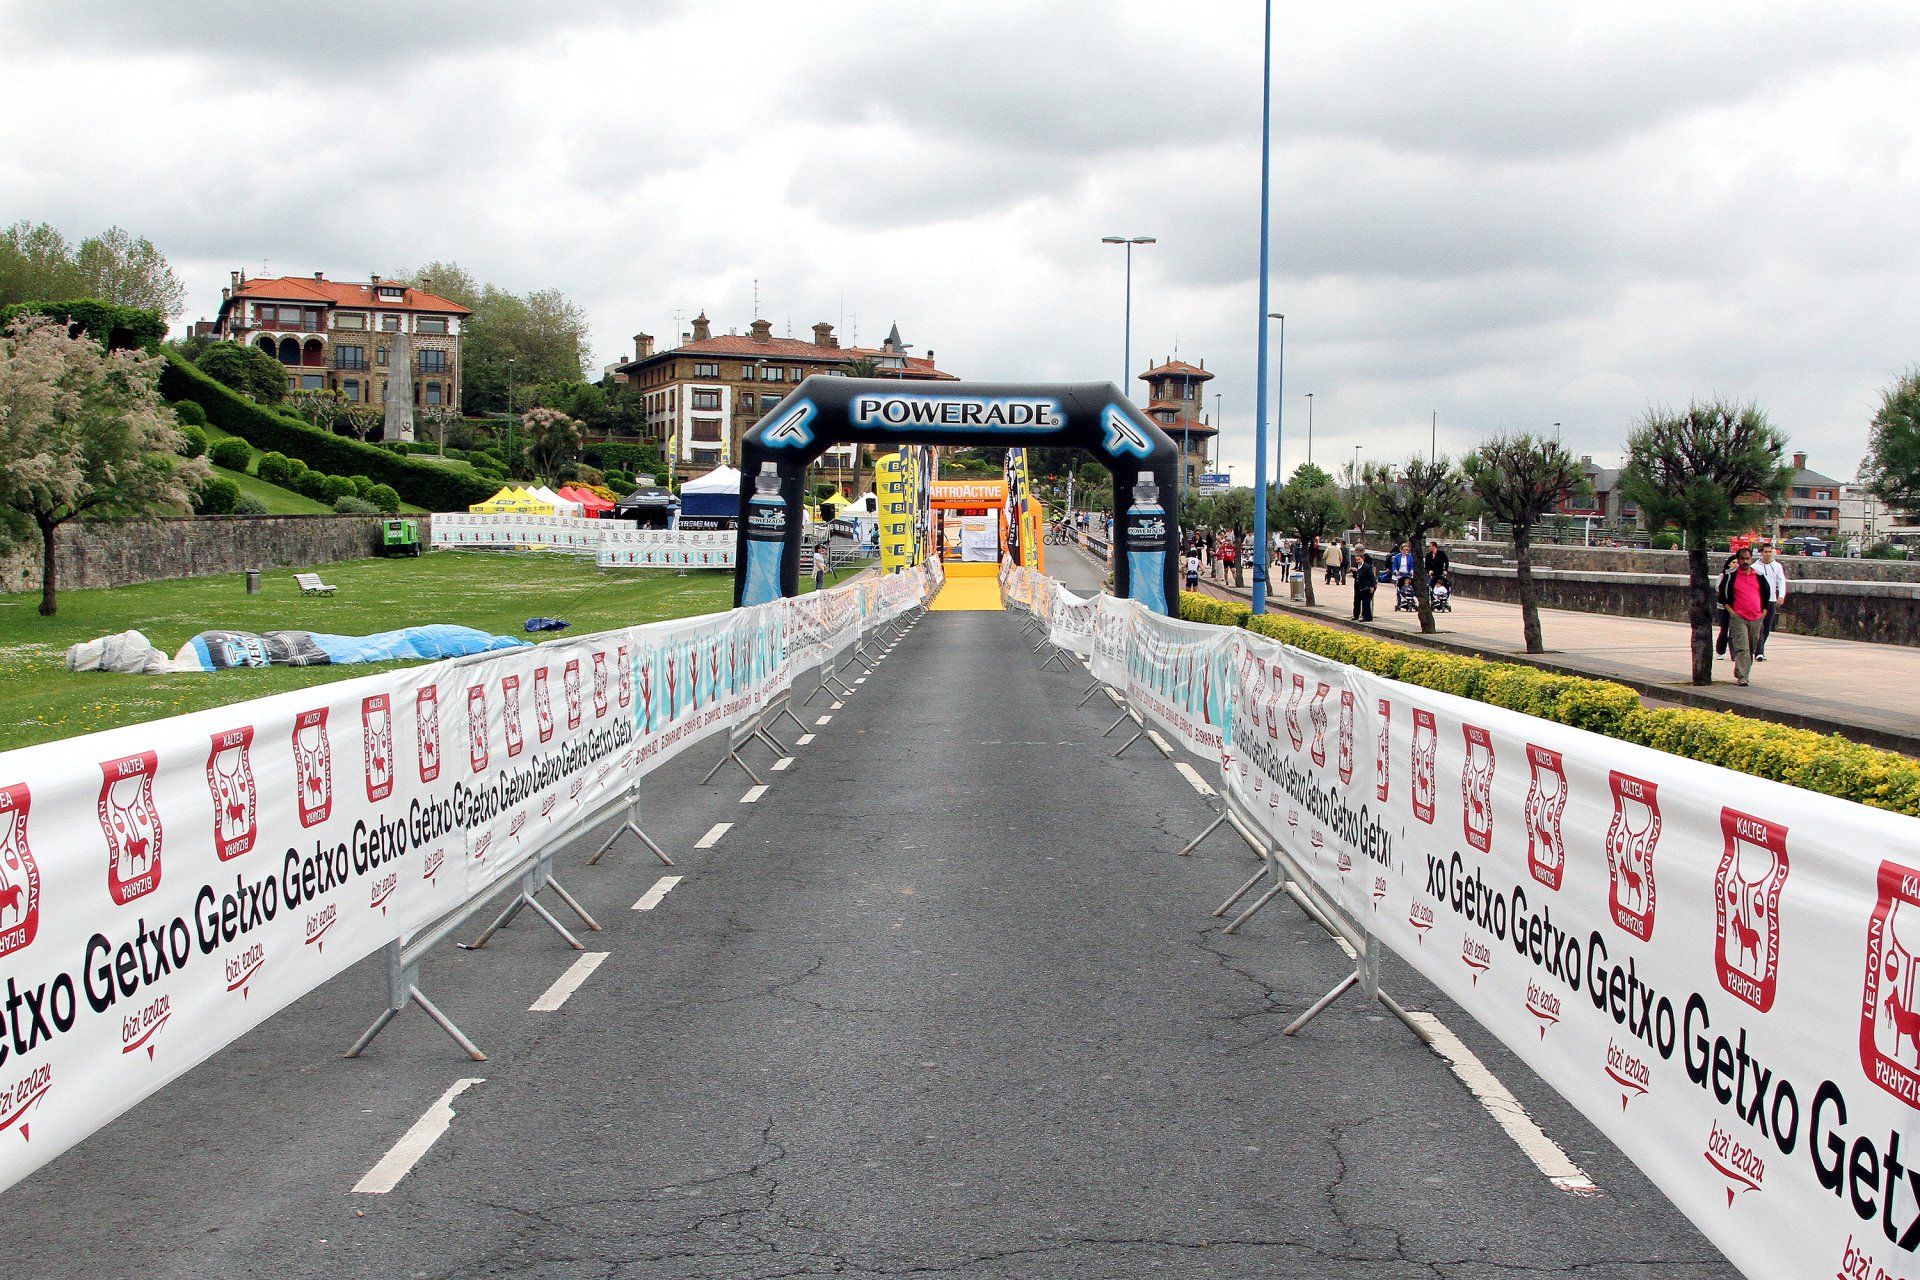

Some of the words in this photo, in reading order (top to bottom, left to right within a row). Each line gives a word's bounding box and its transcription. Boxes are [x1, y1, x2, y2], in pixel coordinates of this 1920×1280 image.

[117, 758, 145, 776] KALTEA
[223, 732, 244, 748] KALTEA
[208, 768, 222, 829] LEPOAN
[242, 750, 256, 827] DAGIANAK
[500, 769, 532, 811] Getxo
[532, 754, 562, 790] Getxo
[1306, 768, 1329, 826] Getxo
[1620, 778, 1644, 800] KALTEA
[99, 800, 118, 868] LEPOAN
[144, 778, 162, 862] DAGIANAK
[410, 794, 450, 849] Getxo
[463, 782, 498, 830] Getxo
[1330, 786, 1358, 848] Getxo
[1554, 780, 1566, 866] DAGIANAK
[1736, 816, 1768, 844] KALTEA
[18, 815, 37, 912] DAGIANAK
[352, 810, 406, 875] Getxo
[1606, 812, 1620, 882] LEPOAN
[1644, 815, 1660, 914] DAGIANAK
[121, 876, 152, 900] BIZARRA
[282, 840, 348, 909] Getxo
[1449, 850, 1506, 942] Getxo
[1716, 854, 1732, 939] LEPOAN
[194, 874, 277, 955] Getxo
[306, 915, 320, 936] bizi
[320, 902, 338, 928] ezazu
[1512, 885, 1581, 992] Getxo
[1617, 908, 1644, 936] BIZARRA
[1766, 864, 1788, 981] DAGIANAK
[83, 917, 190, 1014] Getxo
[226, 958, 241, 984] bizi
[242, 942, 265, 970] ezazu
[1474, 940, 1491, 965] ezazu
[1862, 918, 1884, 1020] LEPOAN
[122, 1014, 140, 1043] bizi
[142, 993, 171, 1027] ezazu
[1526, 977, 1541, 1005] bizi
[1540, 988, 1561, 1016] ezazu
[1587, 930, 1676, 1060] Getxo
[1726, 970, 1762, 1006] BIZARRA
[1607, 1036, 1624, 1070] bizi
[1624, 1050, 1651, 1088] ezazu
[1684, 993, 1797, 1155] Getxo
[1875, 1056, 1920, 1106] IZARRA
[1708, 1119, 1730, 1164] bizi
[1732, 1138, 1766, 1184] ezazu
